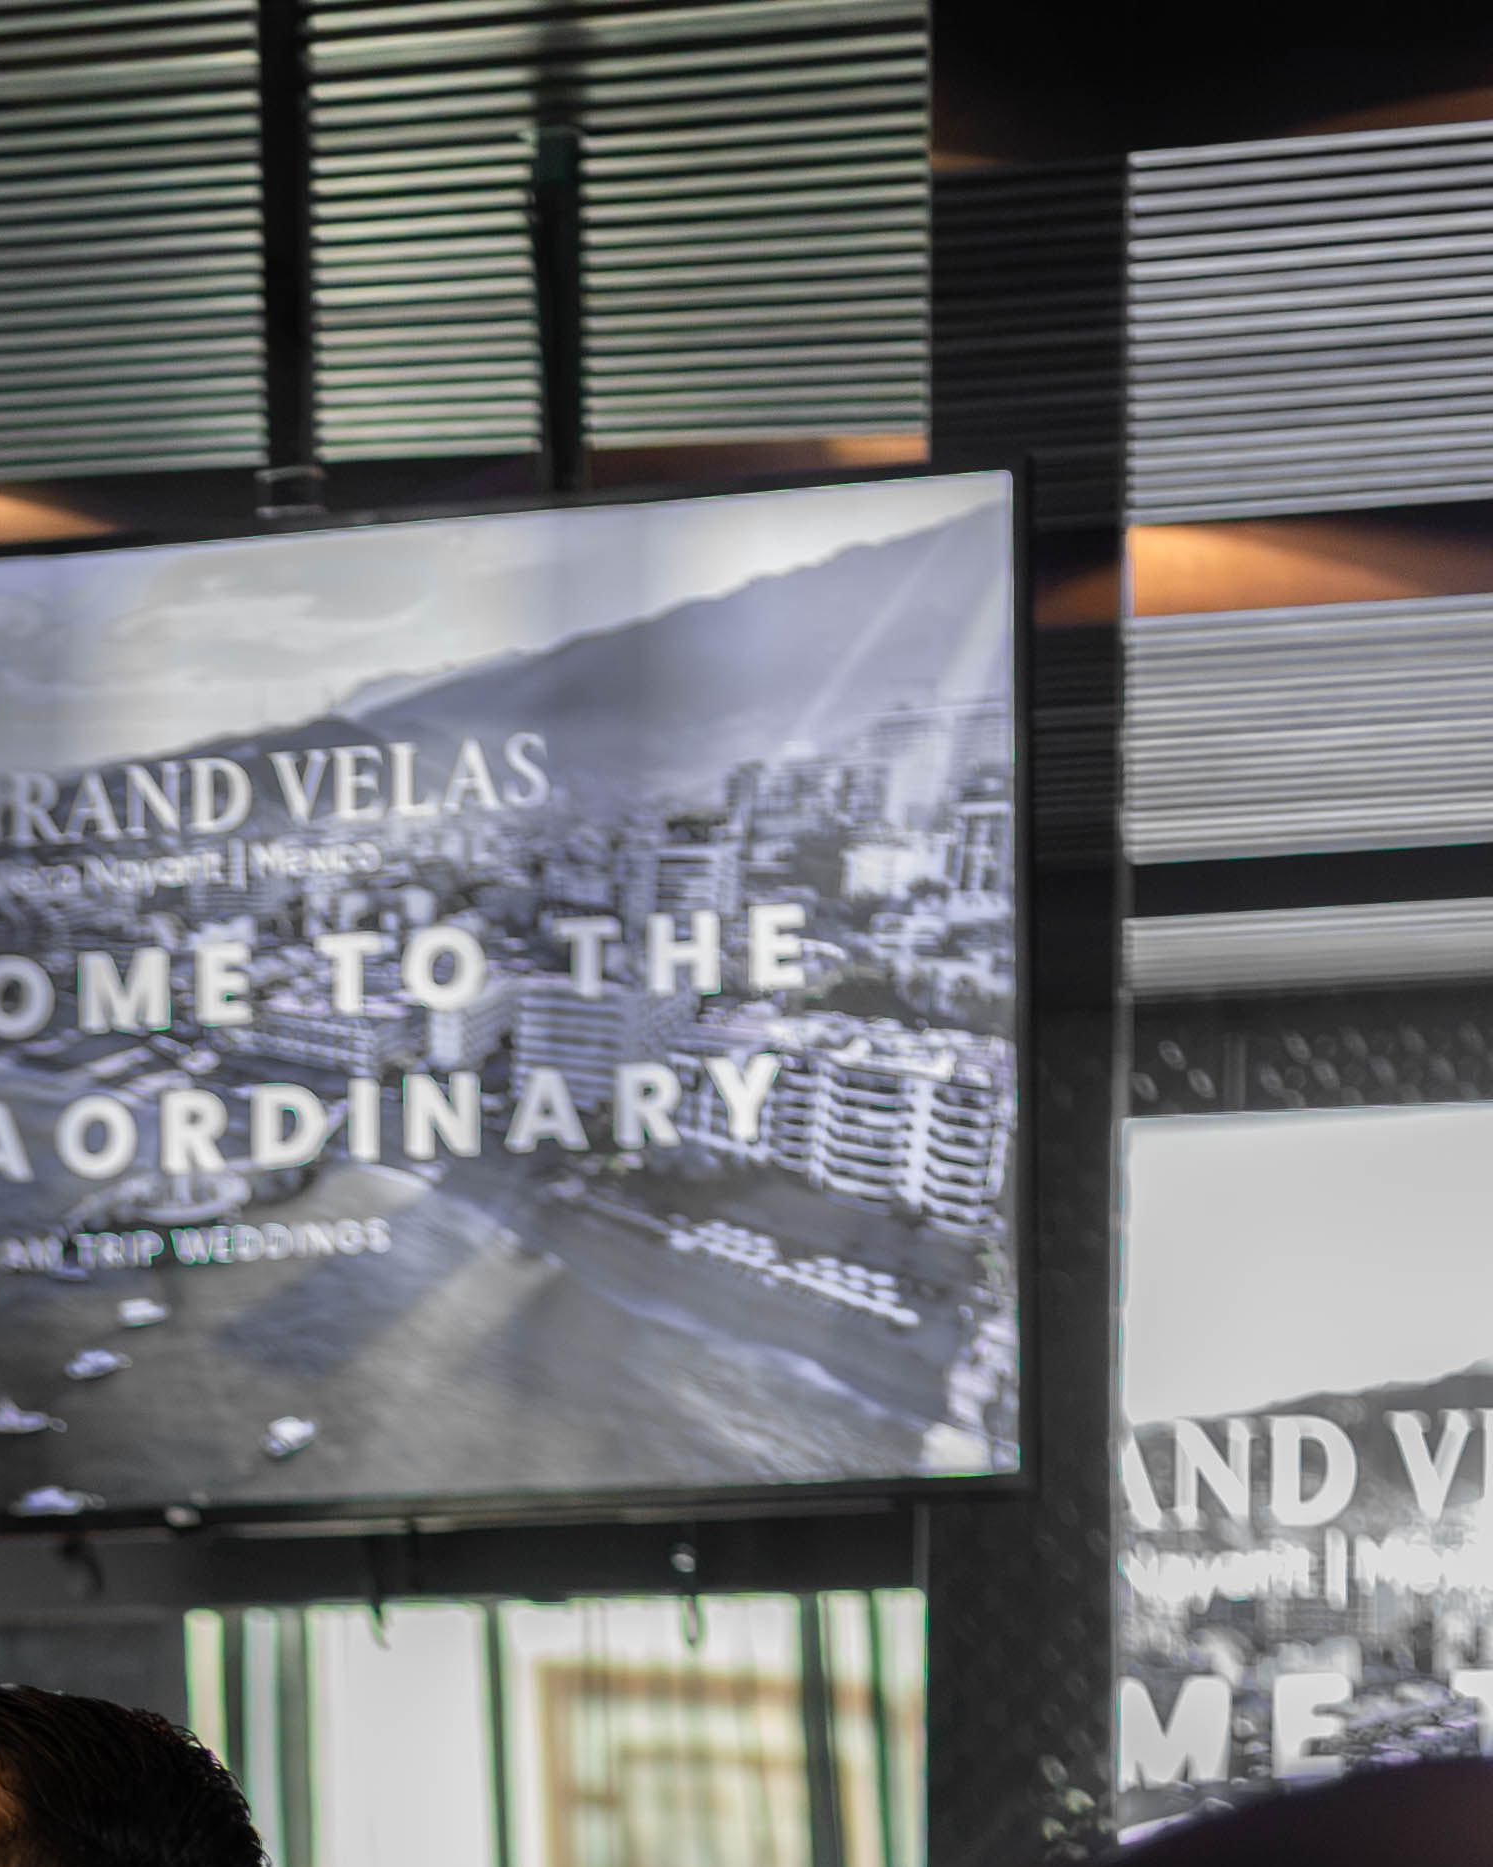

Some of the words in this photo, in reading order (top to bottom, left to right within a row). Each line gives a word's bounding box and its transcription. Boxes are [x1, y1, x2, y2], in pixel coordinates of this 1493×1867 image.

[270, 731, 548, 823] VELAS
[318, 922, 488, 1015] TO
[554, 903, 808, 996] THE
[169, 1217, 393, 1266] WEDDINGS
